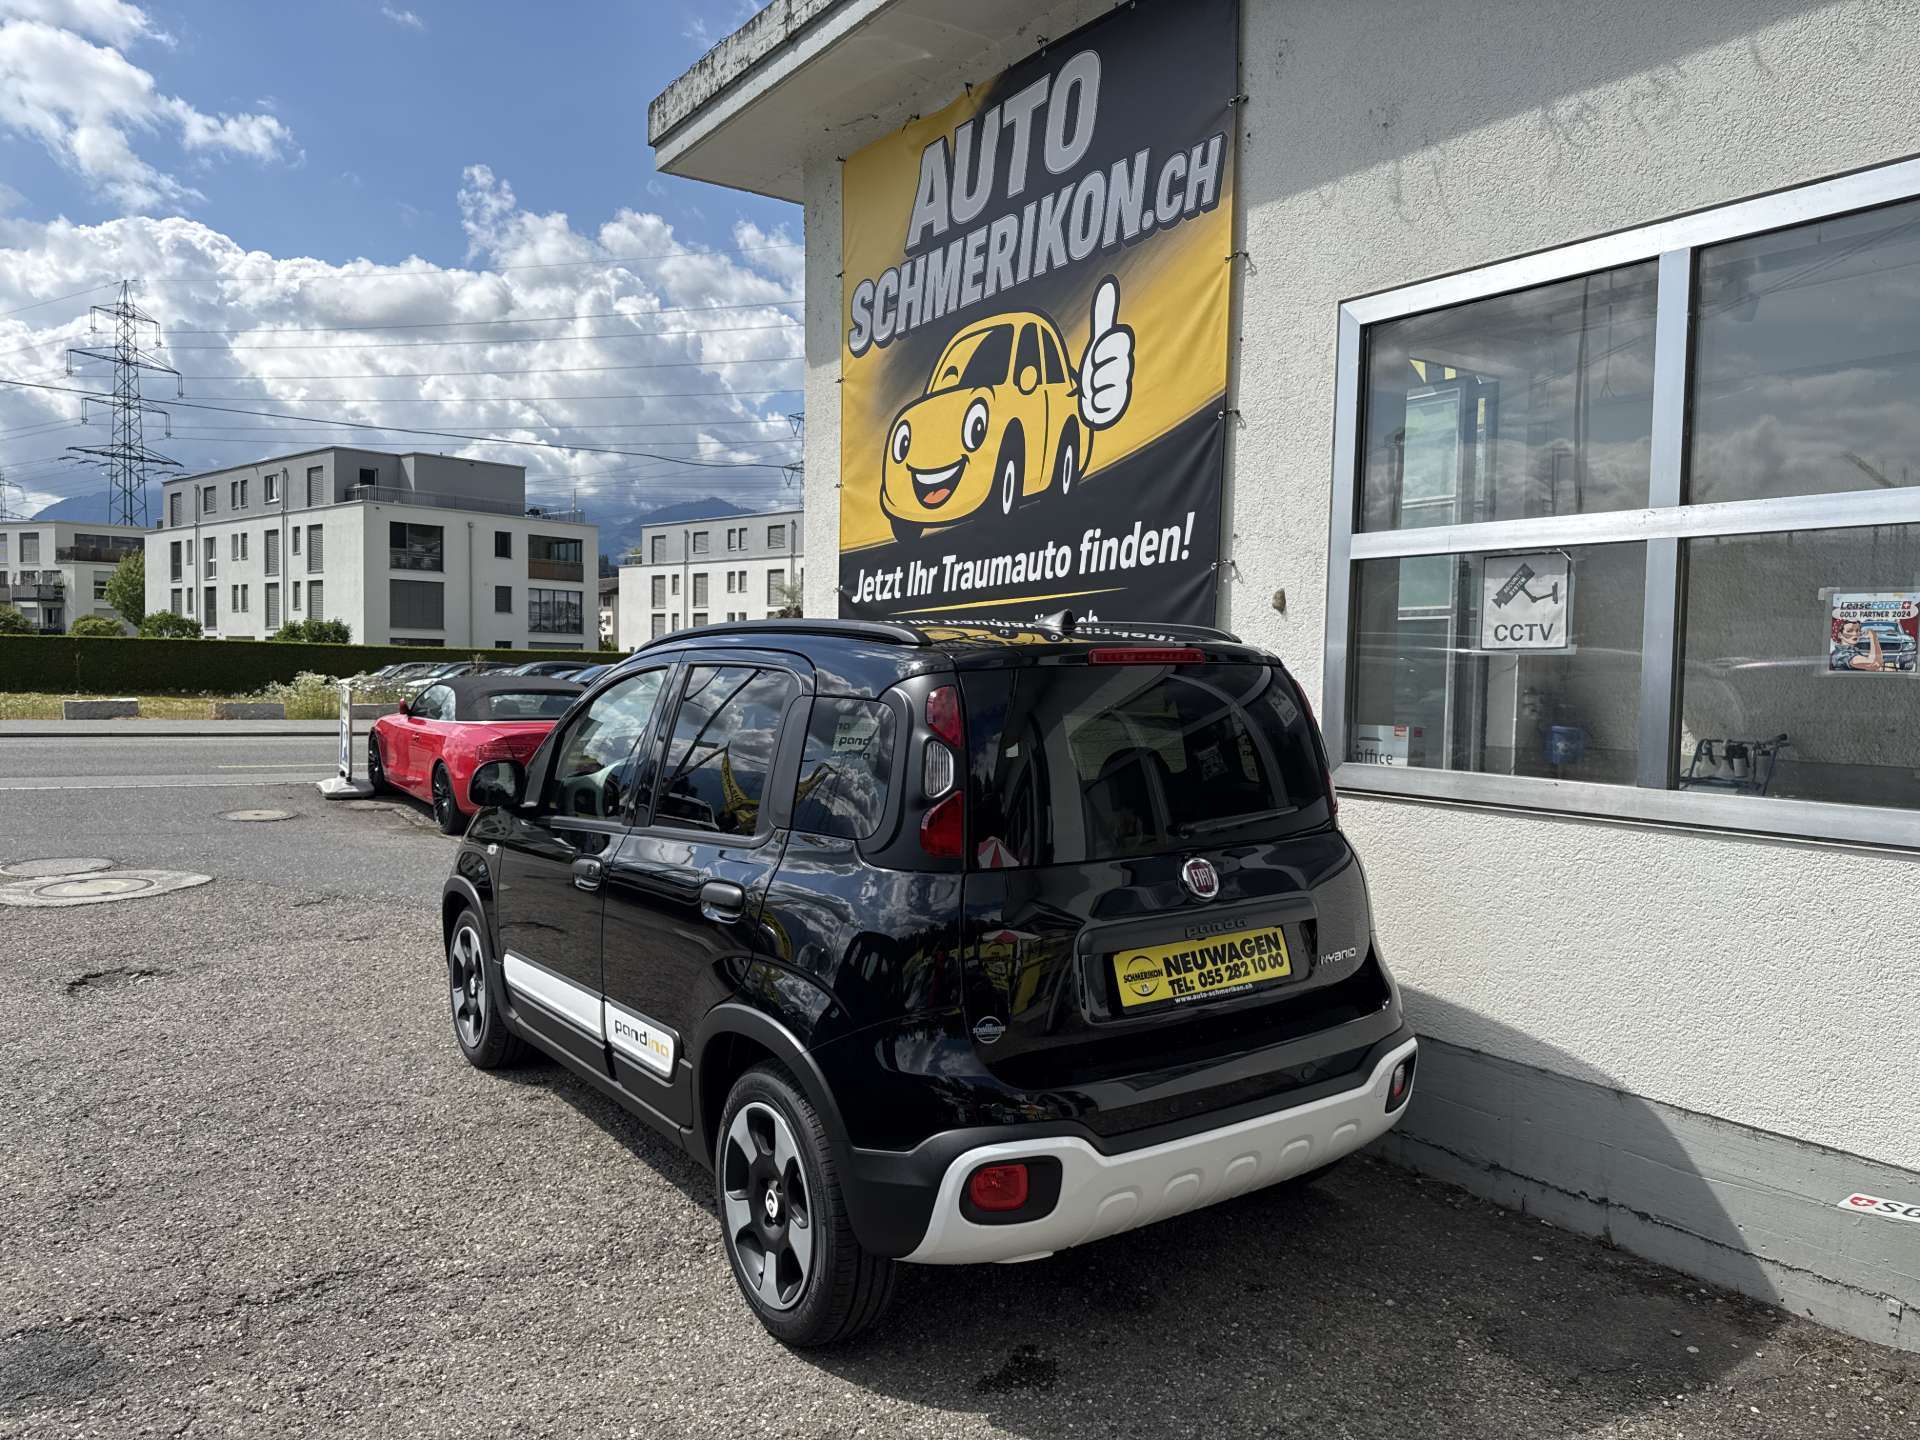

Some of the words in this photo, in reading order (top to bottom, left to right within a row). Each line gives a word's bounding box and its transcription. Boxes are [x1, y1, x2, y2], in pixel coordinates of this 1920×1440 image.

[905, 49, 1101, 251] AUTO
[848, 135, 1224, 353] SCHMERIKON.CH
[851, 569, 903, 604] Jetzt
[906, 560, 938, 597] Ihr
[942, 540, 1072, 593] Traumauto
[1079, 511, 1196, 575] finden!
[1494, 623, 1554, 642] CCTV
[1840, 610, 1857, 618] GOLD
[1860, 610, 1890, 618] PARTNER
[1892, 610, 1911, 618] 2024
[1357, 749, 1393, 765] office
[1191, 868, 1212, 887] FIAT
[1162, 931, 1282, 977] NEUWAGEN
[1168, 976, 1196, 996] TEL:
[1198, 967, 1224, 988] 055
[1225, 960, 1250, 981] 282
[1252, 956, 1267, 975] 10
[1267, 952, 1284, 968] 00
